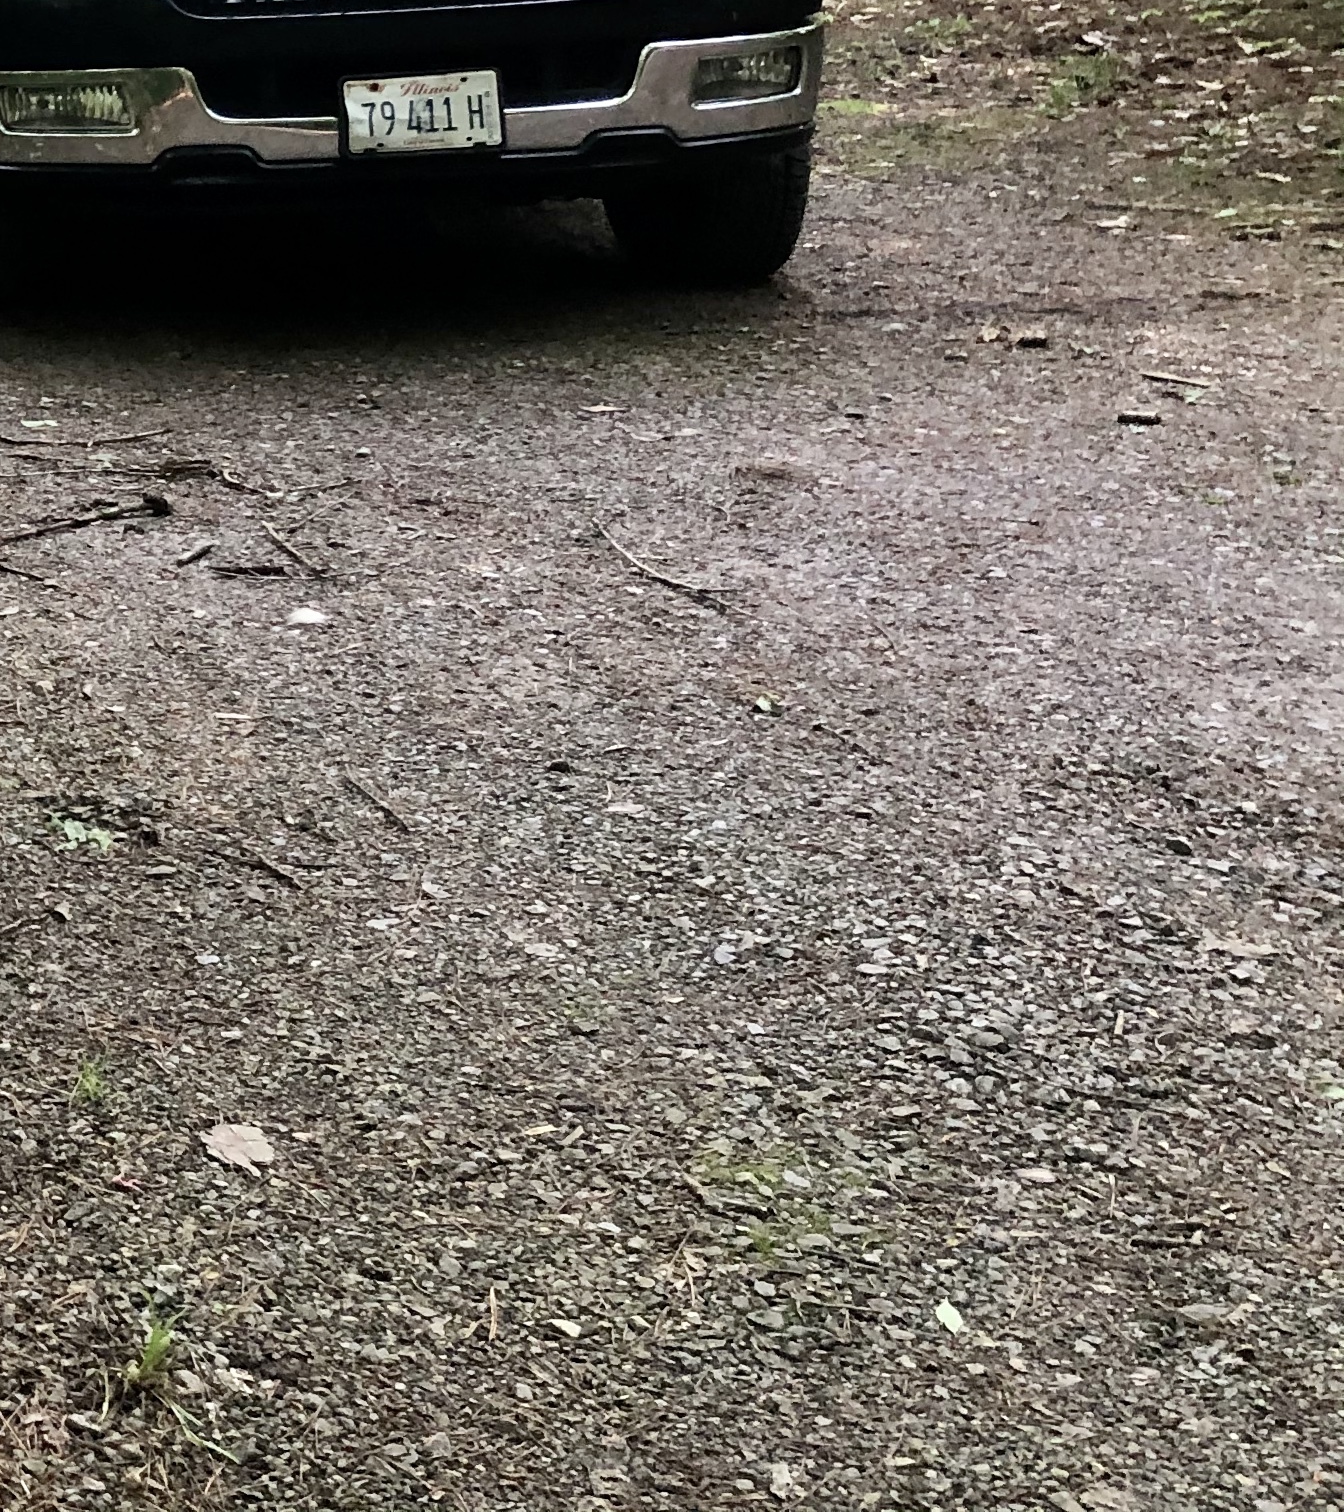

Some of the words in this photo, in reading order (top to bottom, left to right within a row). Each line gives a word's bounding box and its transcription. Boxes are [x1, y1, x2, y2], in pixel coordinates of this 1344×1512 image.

[400, 81, 460, 97] Illinois
[361, 100, 396, 137] 79
[406, 96, 459, 134] 411
[467, 94, 485, 130] H
